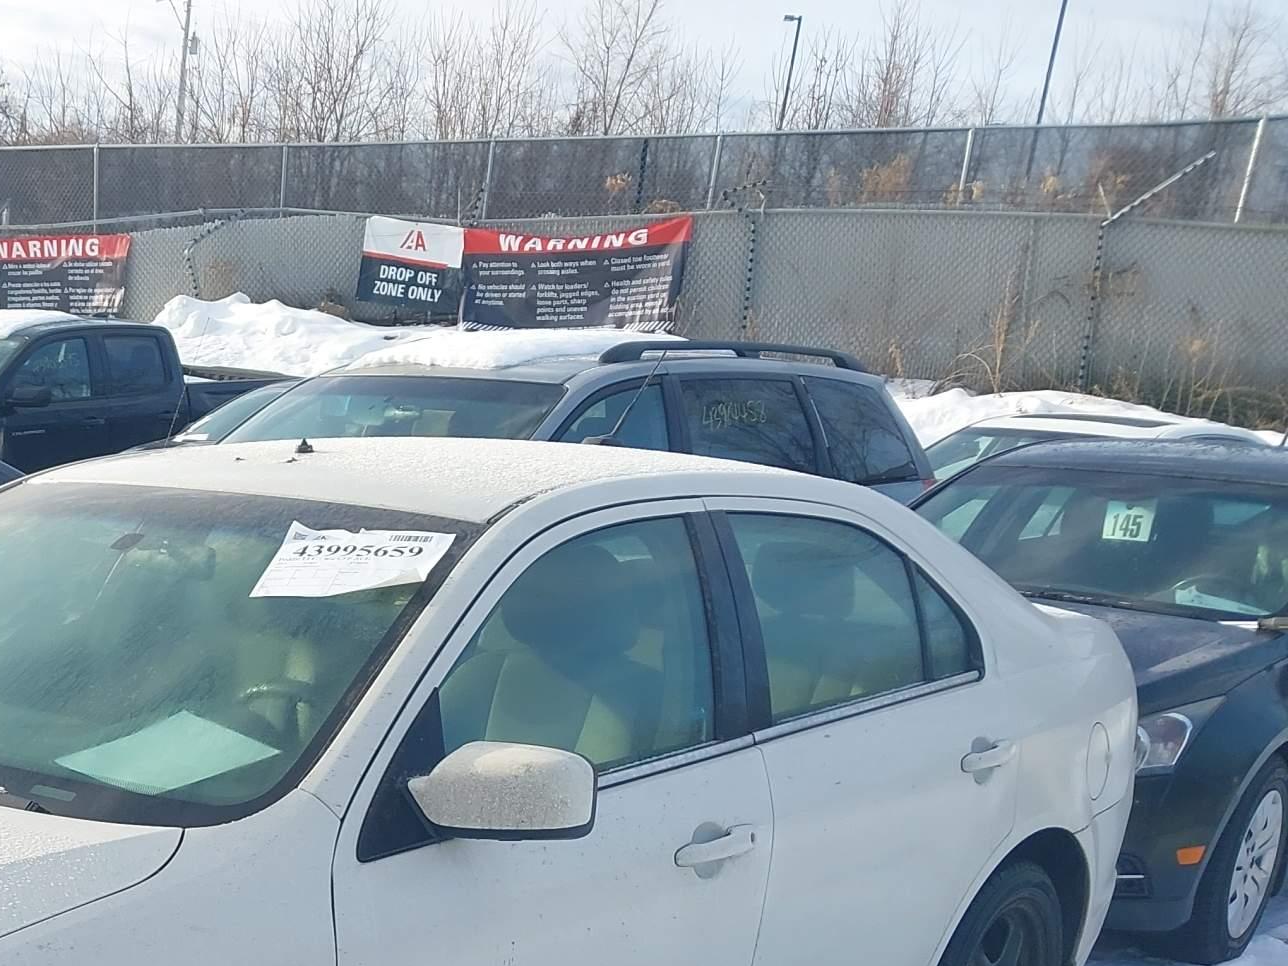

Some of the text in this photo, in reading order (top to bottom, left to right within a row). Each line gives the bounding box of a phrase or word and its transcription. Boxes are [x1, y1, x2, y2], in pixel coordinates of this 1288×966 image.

[499, 228, 649, 252] WARNING
[563, 261, 579, 269] ways
[379, 265, 438, 287] DROP OFF
[611, 279, 631, 288] Health
[631, 278, 642, 286] and
[373, 280, 442, 303] ZONE ONLY
[560, 291, 579, 300] jagged
[536, 314, 558, 322] walking
[293, 544, 425, 558] 43995659
